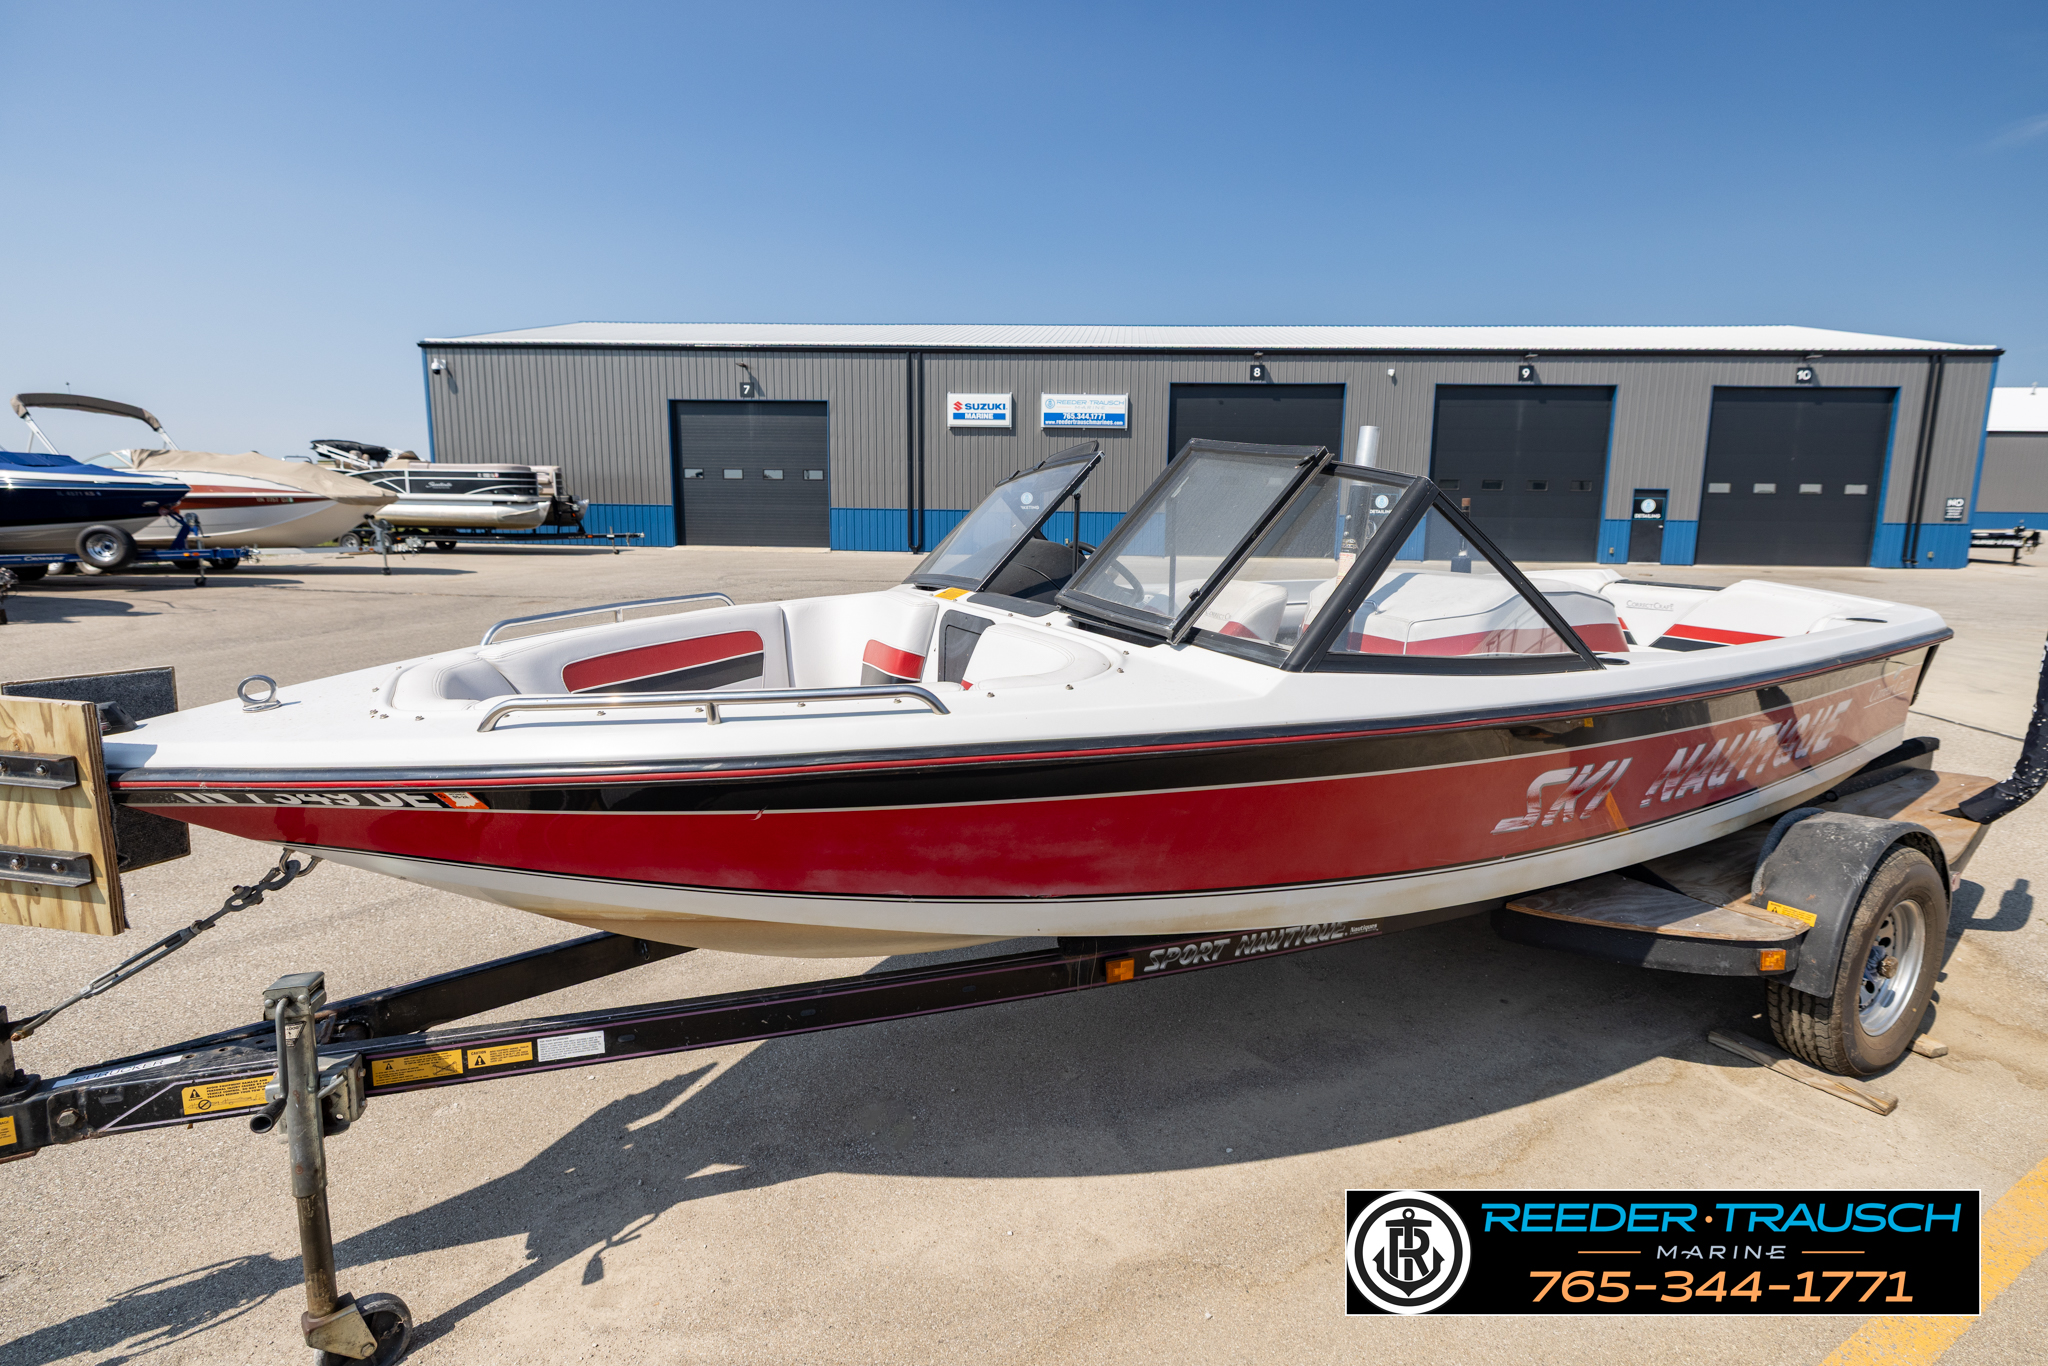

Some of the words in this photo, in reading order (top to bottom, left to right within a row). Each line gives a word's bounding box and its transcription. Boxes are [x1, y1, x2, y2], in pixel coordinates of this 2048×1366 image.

[1253, 367, 1261, 377] 8
[1522, 367, 1531, 379] 9
[1796, 369, 1812, 381] 10
[743, 384, 751, 395] 7
[964, 402, 1006, 411] SUZUKI
[964, 412, 994, 420] MARINE
[1062, 412, 1106, 420] 765.344.1771
[1946, 498, 1965, 507] NO
[1491, 757, 1633, 835] SKI
[1639, 699, 1853, 809] NAUTIQUE
[1143, 938, 1231, 973] SPORT
